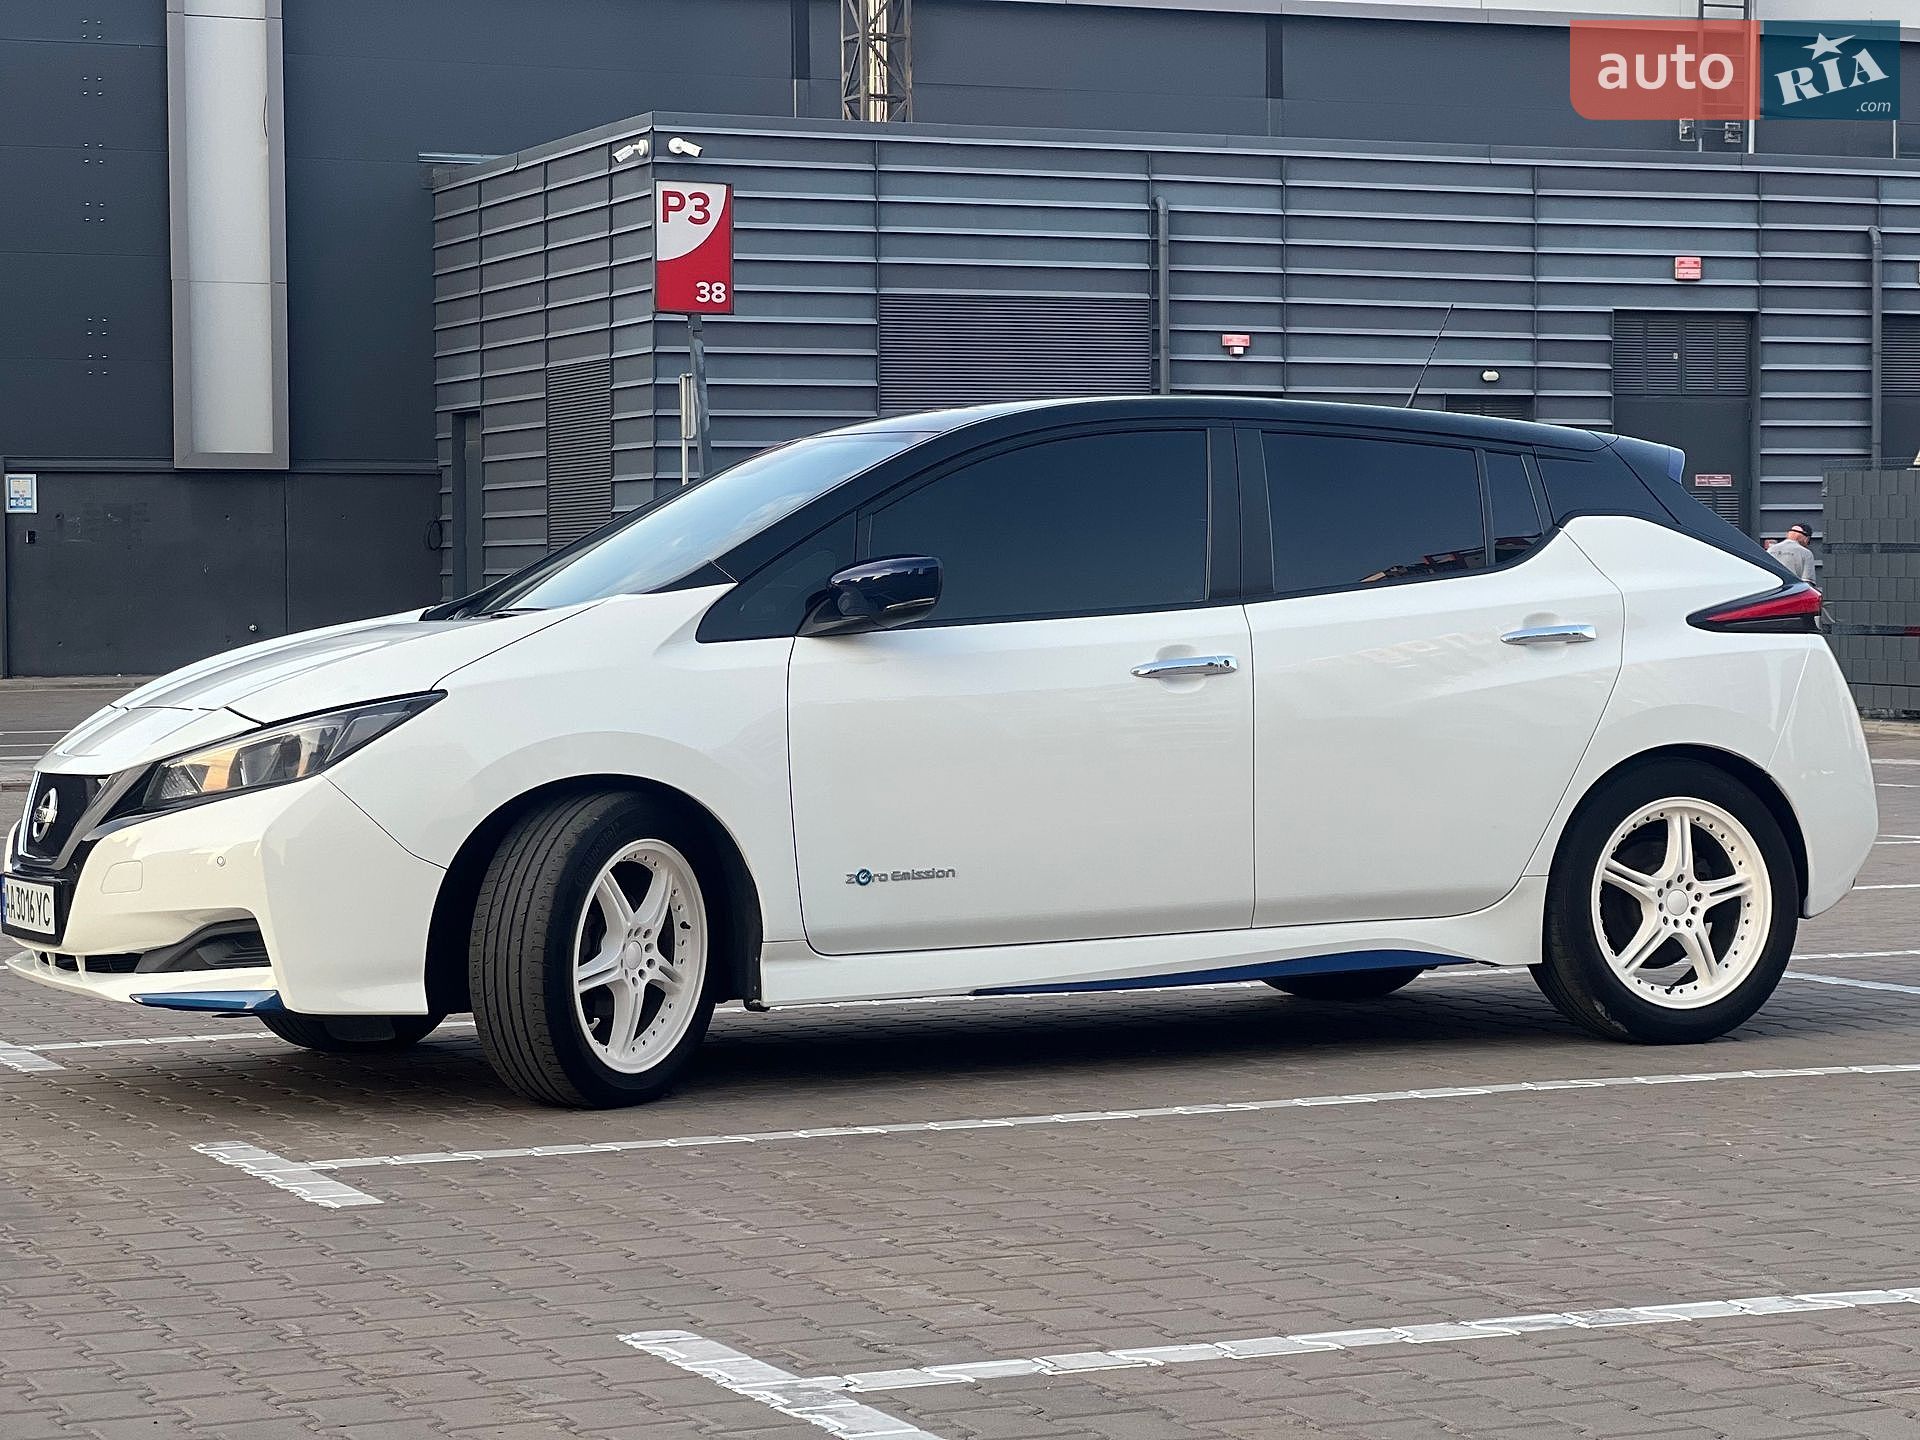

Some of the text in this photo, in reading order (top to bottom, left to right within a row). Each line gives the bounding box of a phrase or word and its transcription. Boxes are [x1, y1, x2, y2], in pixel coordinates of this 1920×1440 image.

[661, 189, 712, 226] P3
[695, 280, 727, 304] 38
[16, 886, 36, 924] 3016
[36, 891, 51, 927] YC
